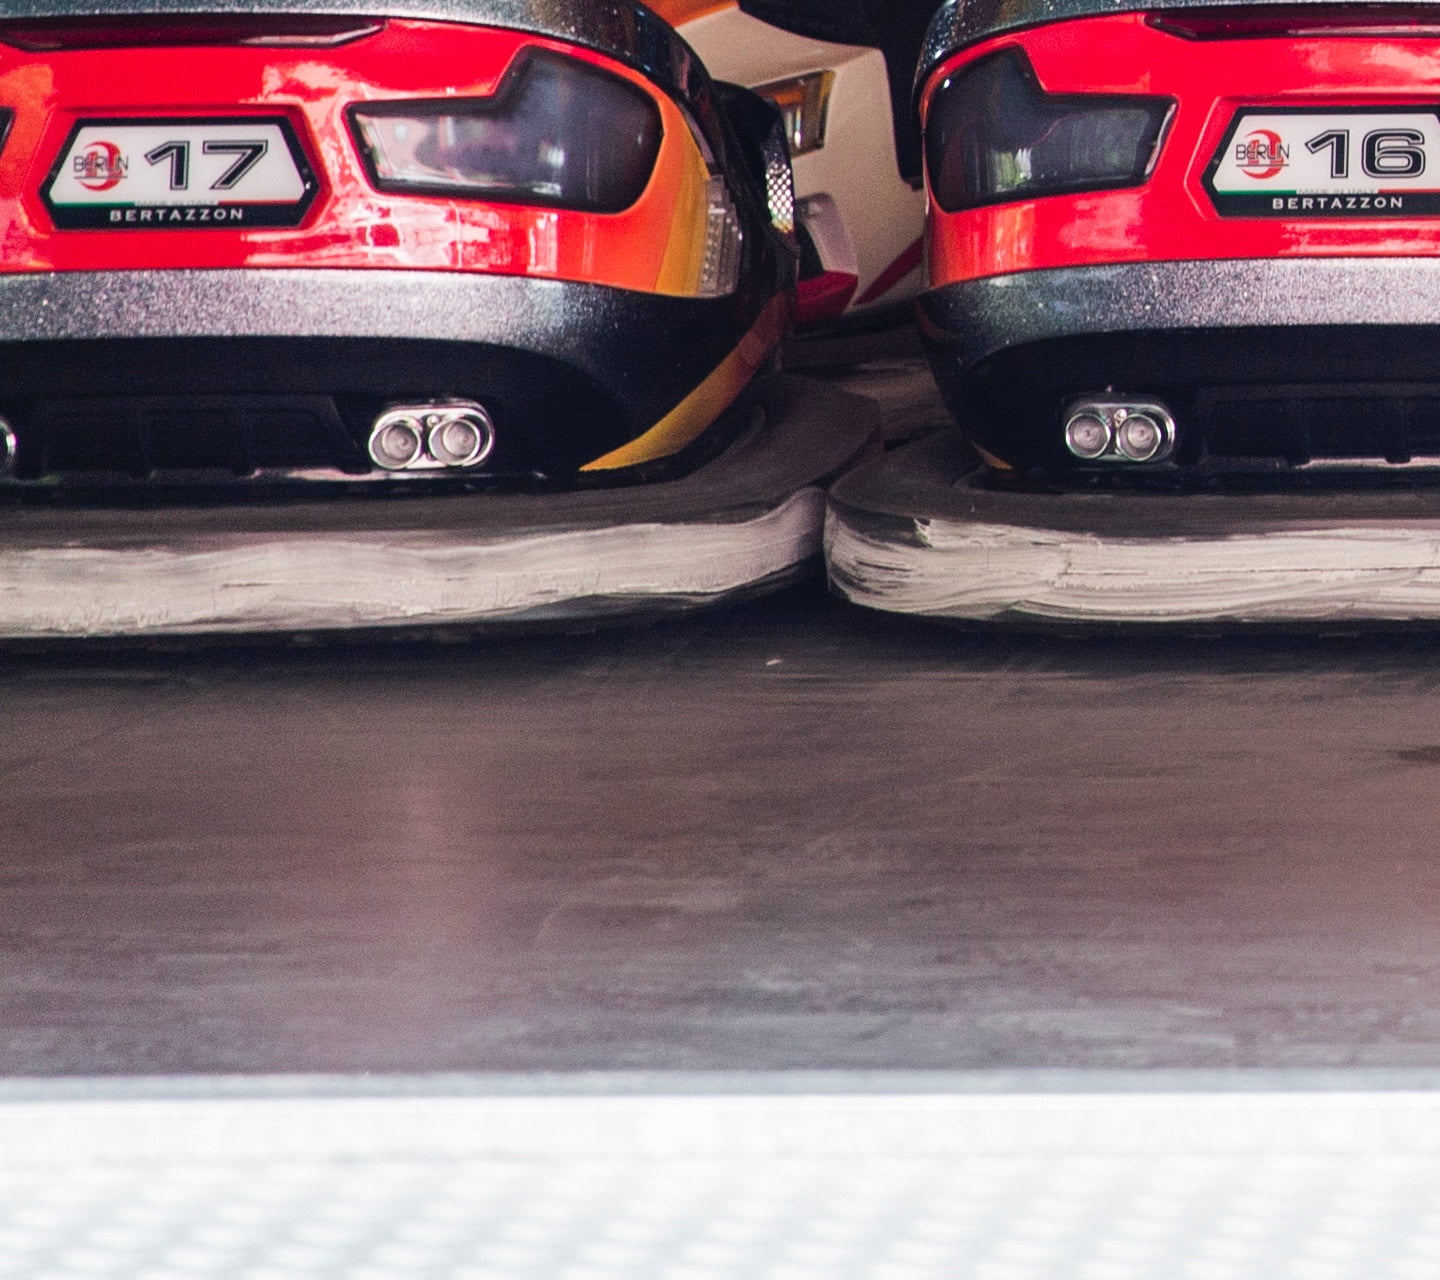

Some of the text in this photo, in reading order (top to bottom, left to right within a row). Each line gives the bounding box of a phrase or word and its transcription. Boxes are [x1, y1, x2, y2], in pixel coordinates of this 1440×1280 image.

[73, 139, 269, 190] BERLIN 17
[1235, 128, 1425, 179] BERLIN 16
[109, 208, 244, 222] BERTAZZON
[1272, 197, 1403, 209] BERTAZZON
